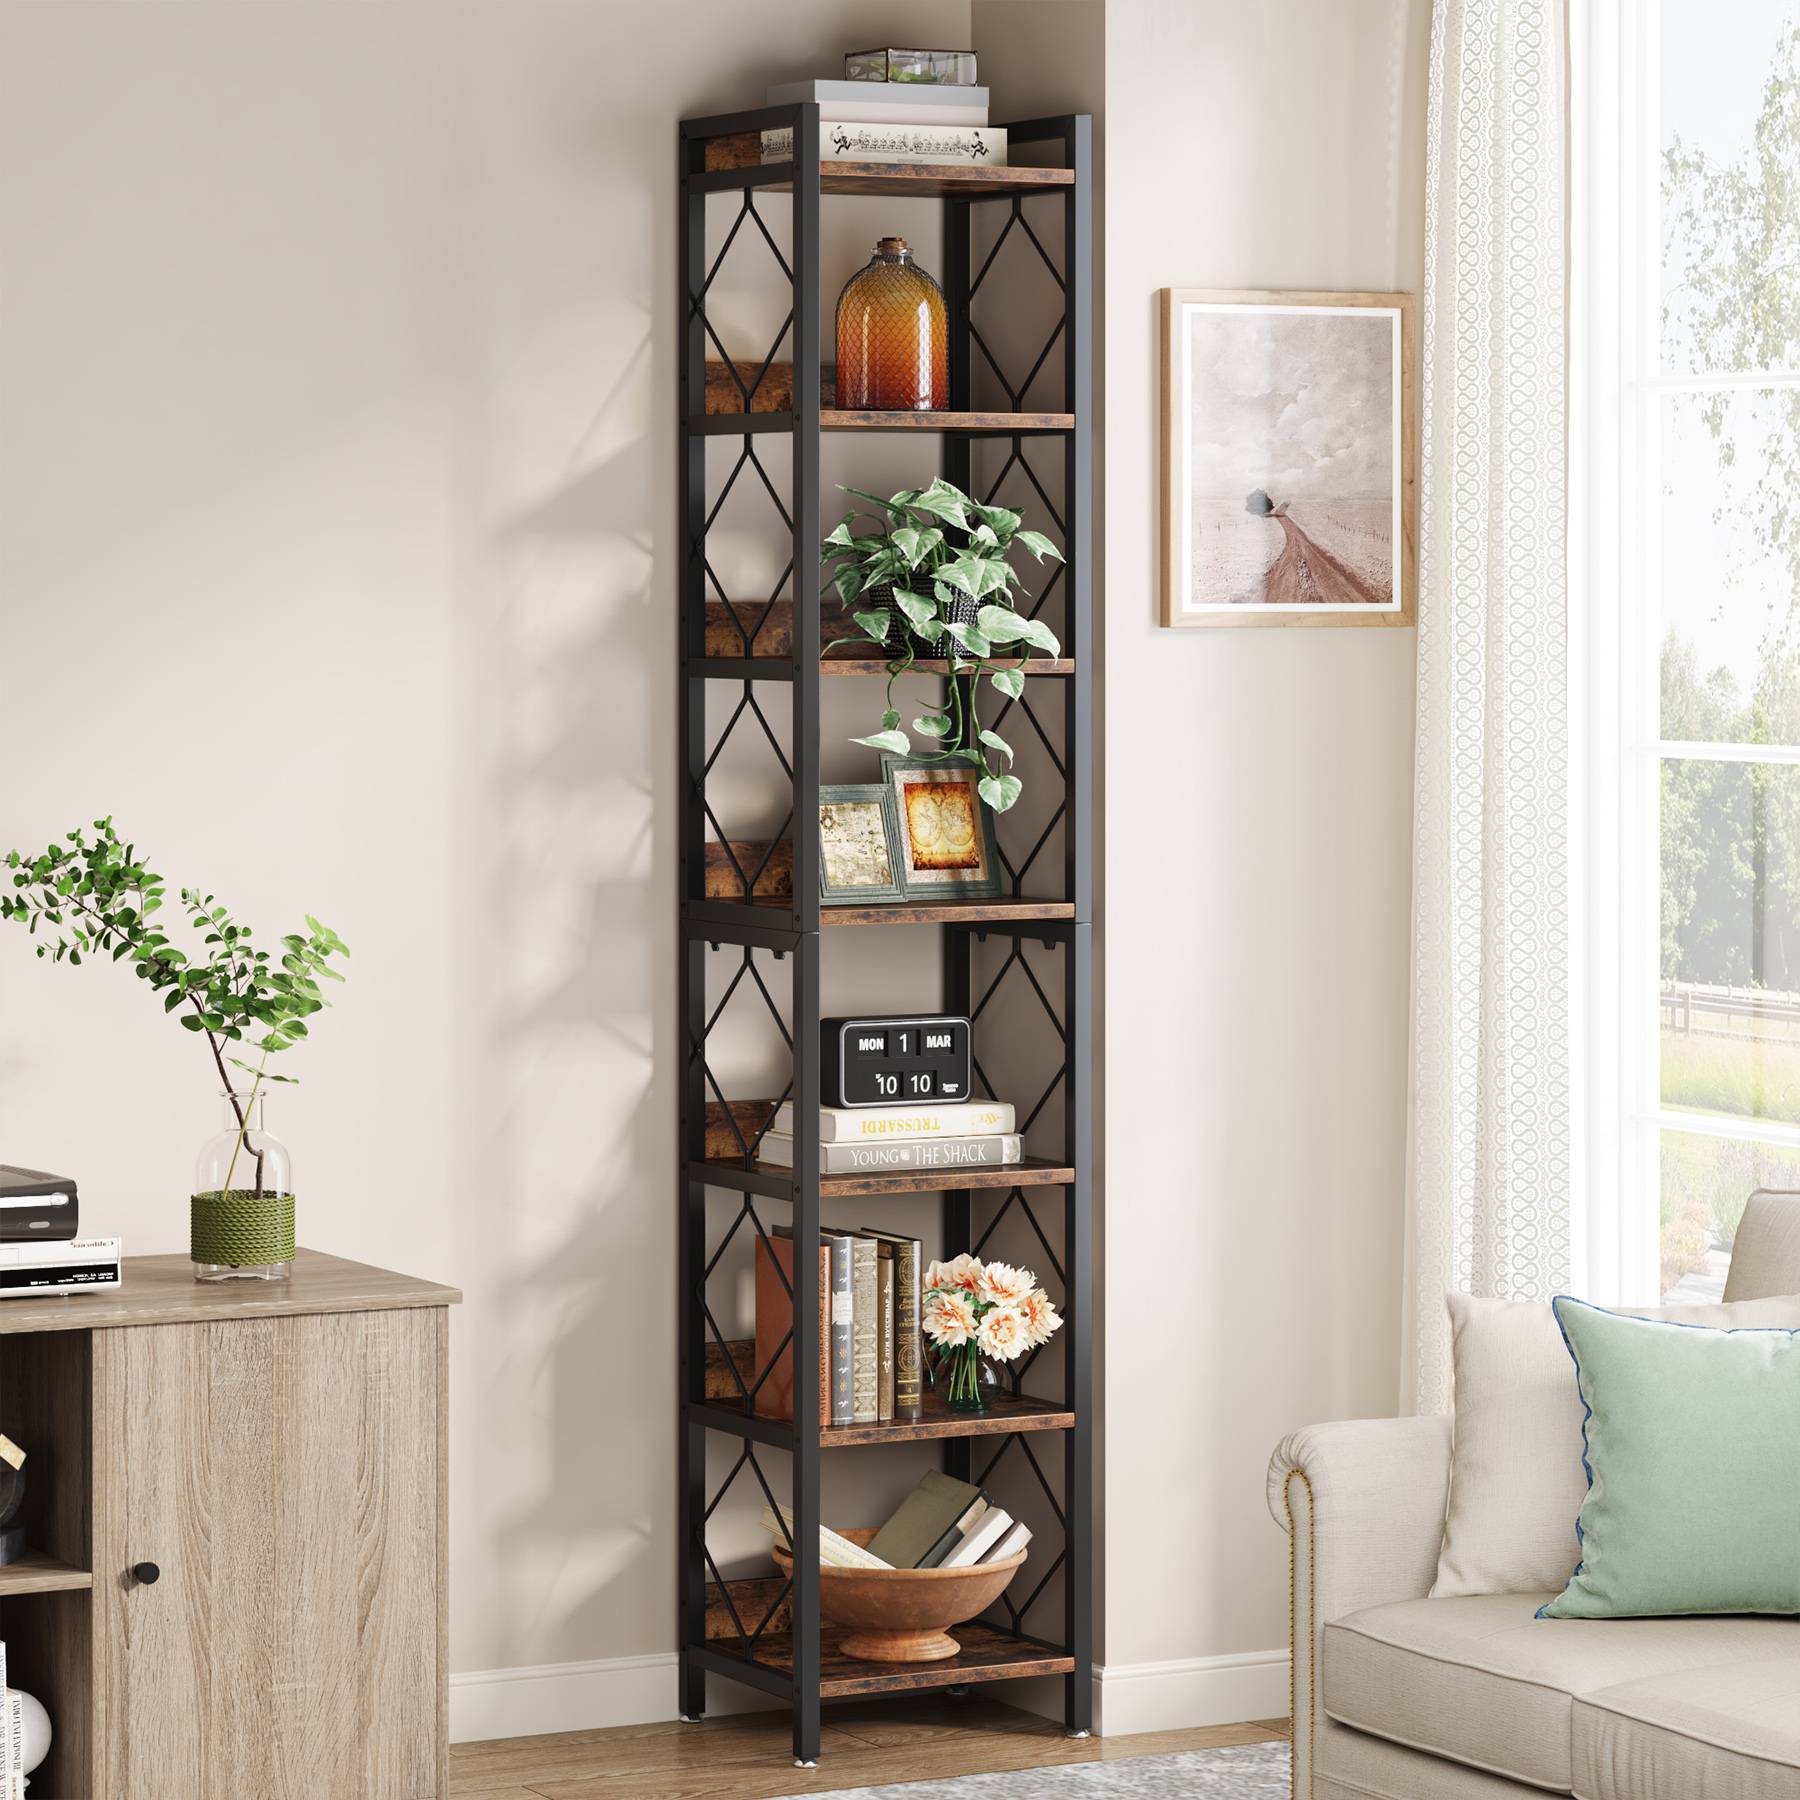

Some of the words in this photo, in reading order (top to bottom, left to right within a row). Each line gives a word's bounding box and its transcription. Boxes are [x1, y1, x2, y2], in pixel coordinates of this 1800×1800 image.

[859, 1038, 884, 1051] MON
[899, 1033, 908, 1053] 1
[926, 1035, 951, 1049] MAR
[877, 1076, 898, 1095] 10
[910, 1074, 931, 1093] 10
[861, 1117, 941, 1134] TRUSSARDI
[850, 1148, 899, 1166] YOUNG
[912, 1145, 942, 1164] THE
[943, 1143, 987, 1163] SHACK
